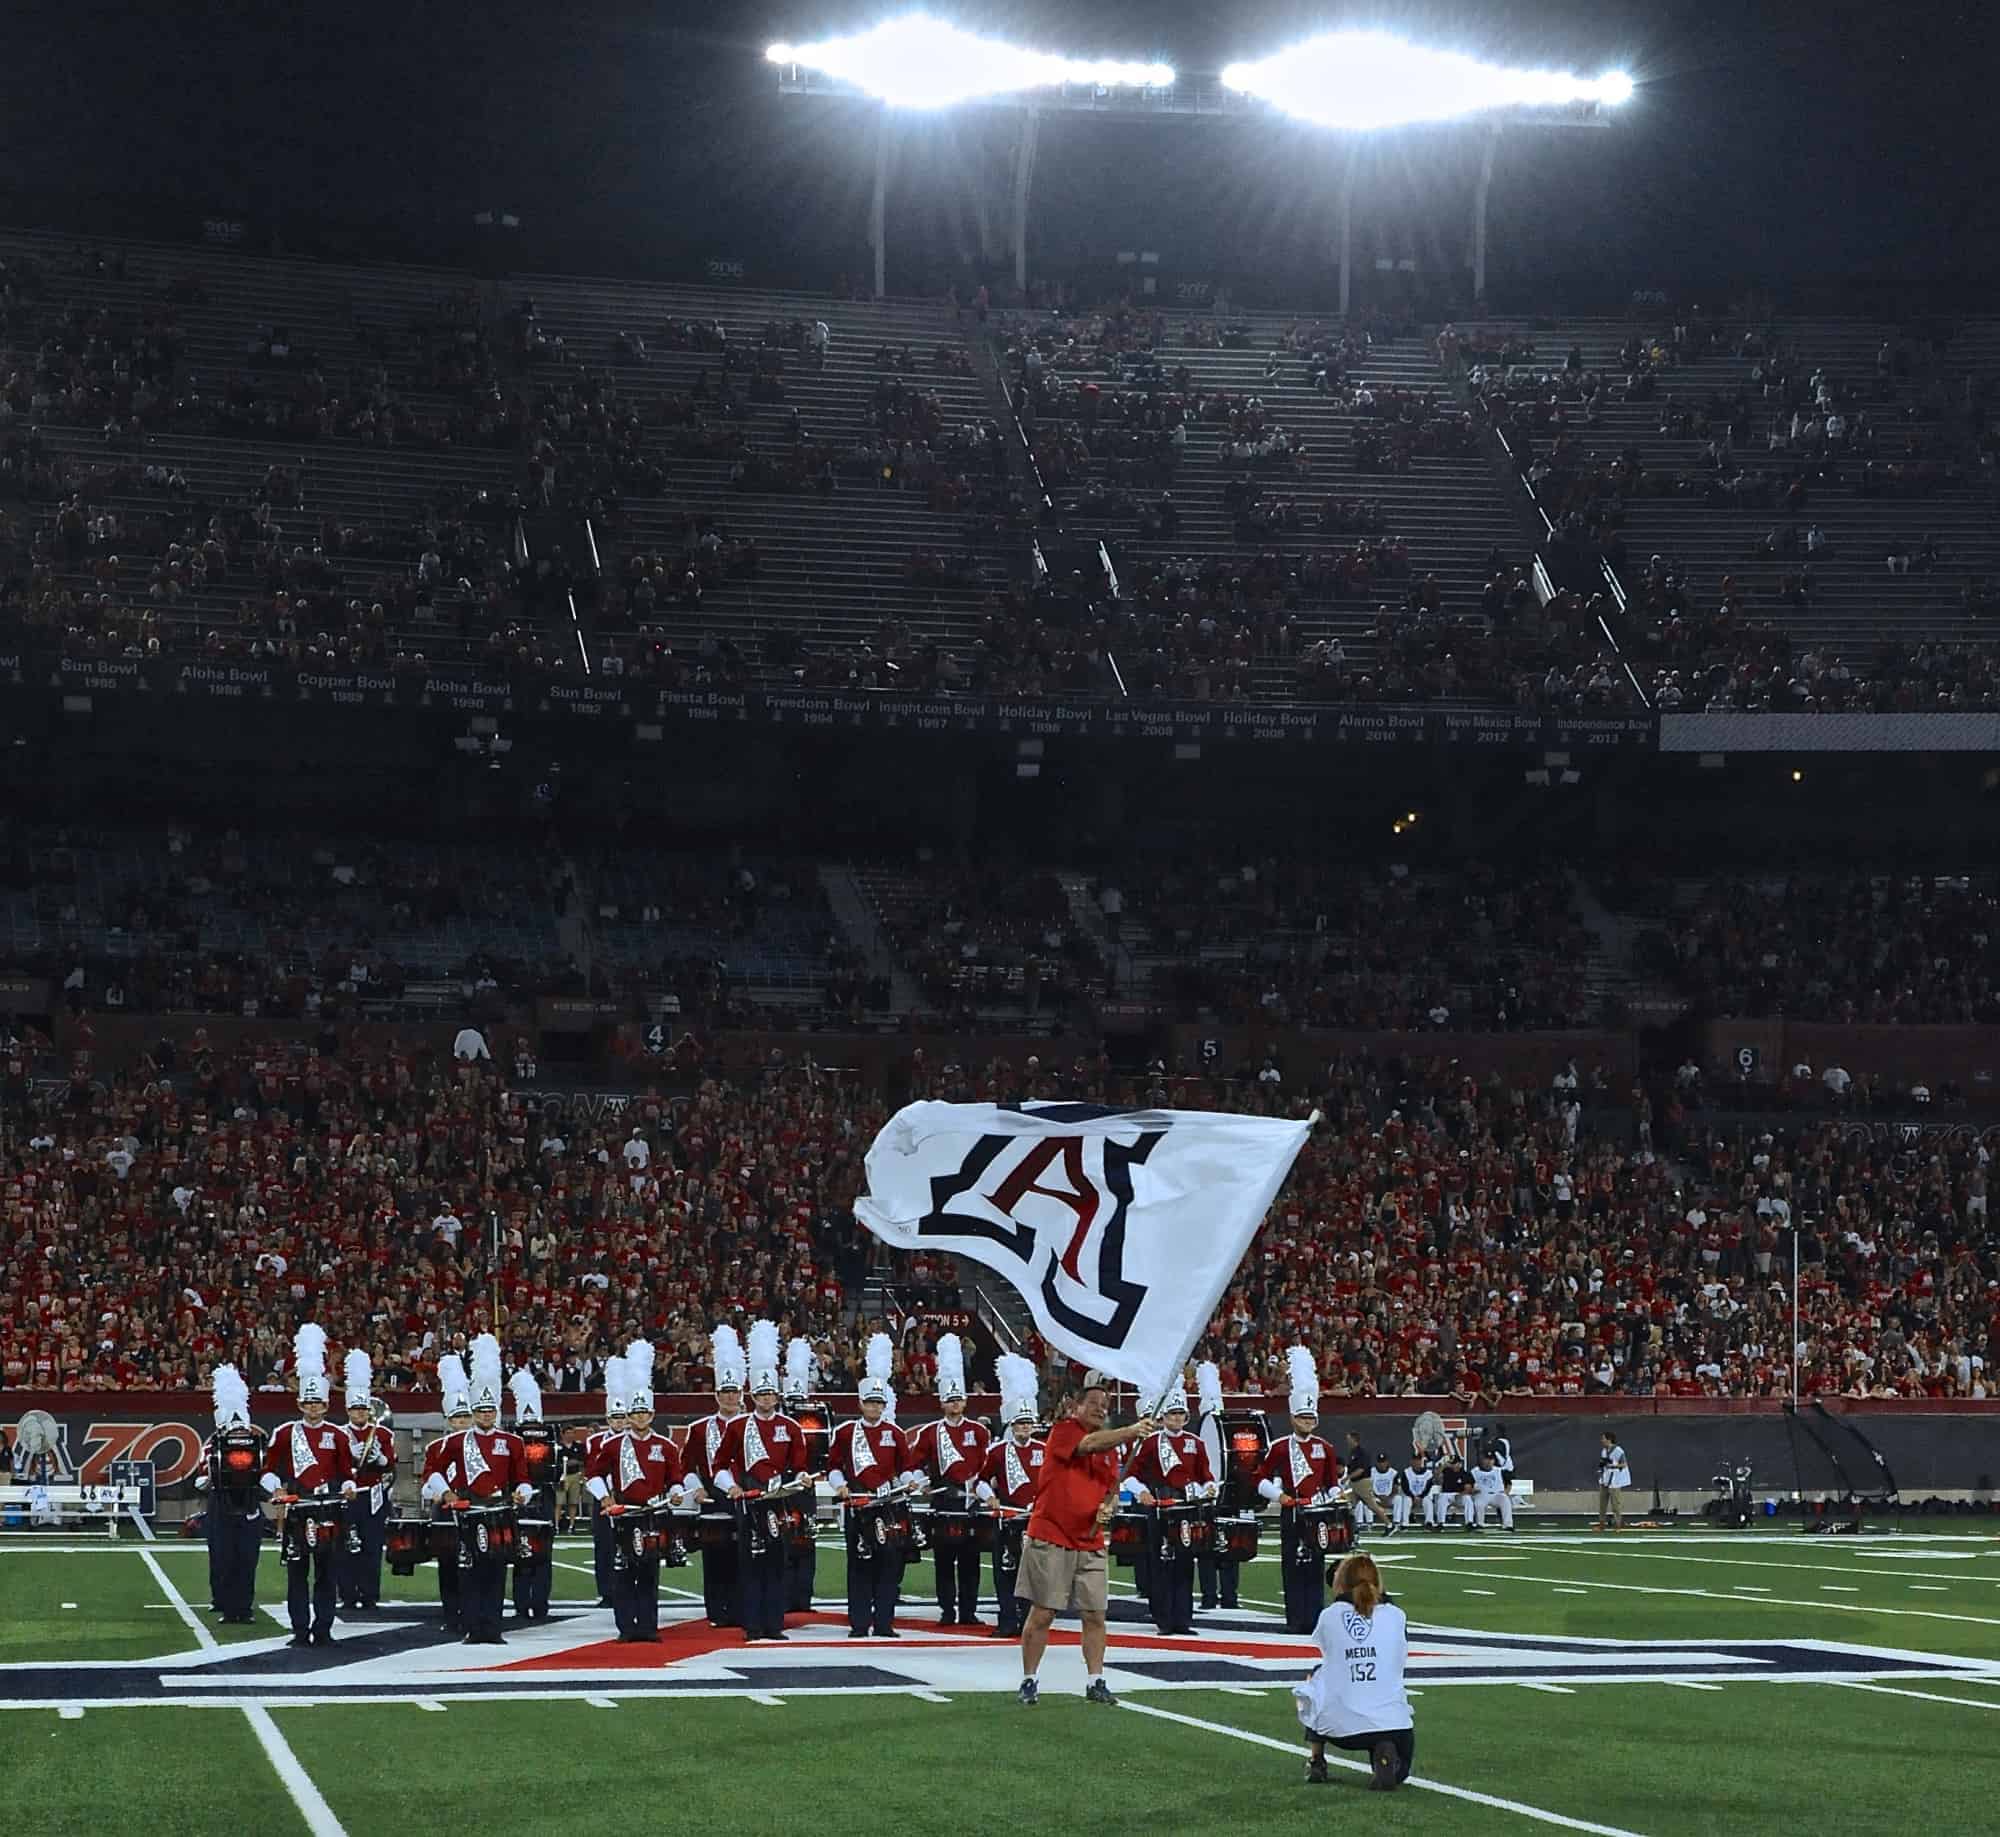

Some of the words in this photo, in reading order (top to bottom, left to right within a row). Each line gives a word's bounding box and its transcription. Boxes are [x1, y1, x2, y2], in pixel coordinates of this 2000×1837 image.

[61, 657, 93, 672] Sun
[97, 660, 138, 675] Bowl
[181, 665, 225, 680] Aloha
[229, 668, 269, 682] Bowl
[297, 672, 353, 689] Copper
[356, 675, 397, 690] Bowl
[424, 679, 469, 694] Aloha
[472, 681, 511, 696] Bowl
[550, 685, 580, 698] Sun
[583, 688, 623, 702] Bowl
[659, 690, 704, 704] Fiesta
[707, 692, 745, 706] Bowl
[766, 696, 830, 711] Freedom
[833, 698, 871, 712] Bowl
[953, 703, 985, 717] Bowl
[999, 704, 1053, 721] Holiday
[1055, 706, 1093, 721] Bowl
[1105, 707, 1129, 721] Las
[1130, 710, 1172, 725] Vegas
[1175, 711, 1211, 724] Bowl
[1223, 711, 1278, 729] Holiday
[1280, 712, 1318, 727] Bowl
[1338, 713, 1384, 728] Alamo
[1387, 714, 1424, 729] Bowl
[1445, 715, 1472, 729] New
[1473, 715, 1512, 730] Mexico
[1513, 716, 1542, 730] Bowl
[1627, 718, 1653, 731] Bowl
[648, 1025, 664, 1043] 4
[1203, 1040, 1217, 1057] 5
[1738, 1048, 1753, 1067] 6
[1353, 1626, 1366, 1637] 12
[1345, 1646, 1377, 1660] MEDIA
[1350, 1662, 1377, 1682] 152
